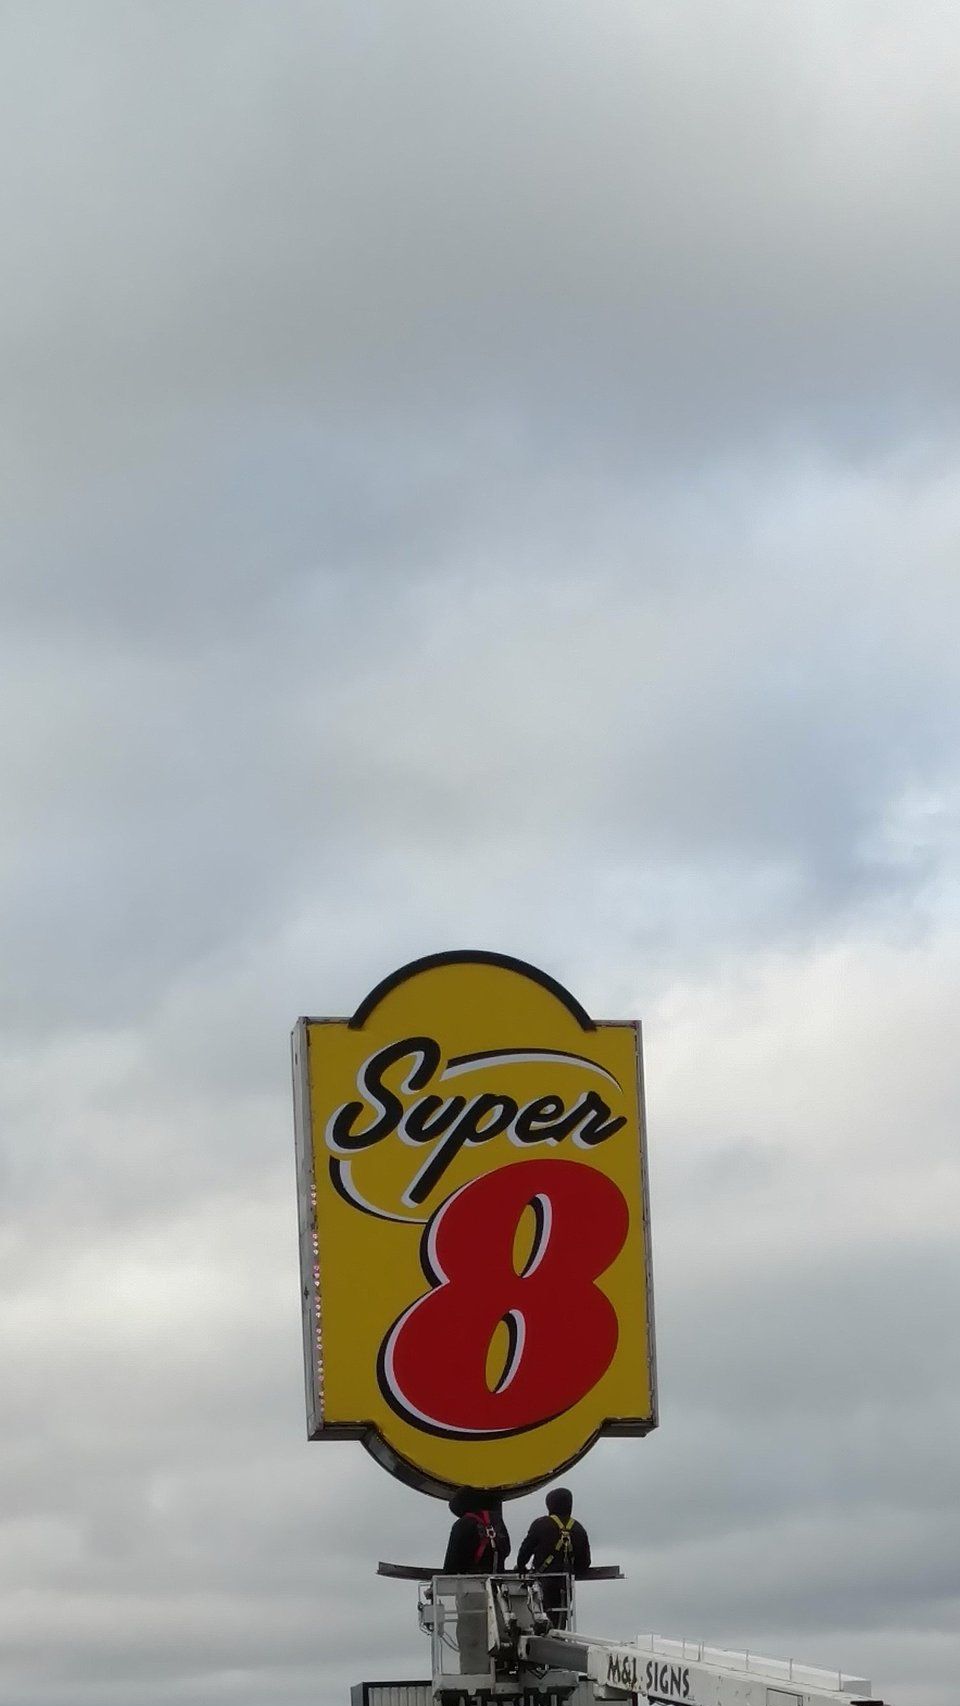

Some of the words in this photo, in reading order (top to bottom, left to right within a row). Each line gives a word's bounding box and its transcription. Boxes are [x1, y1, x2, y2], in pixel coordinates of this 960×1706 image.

[326, 1036, 628, 1208] Super
[376, 1158, 630, 1442] 8
[646, 1661, 690, 1698] SIGNS
